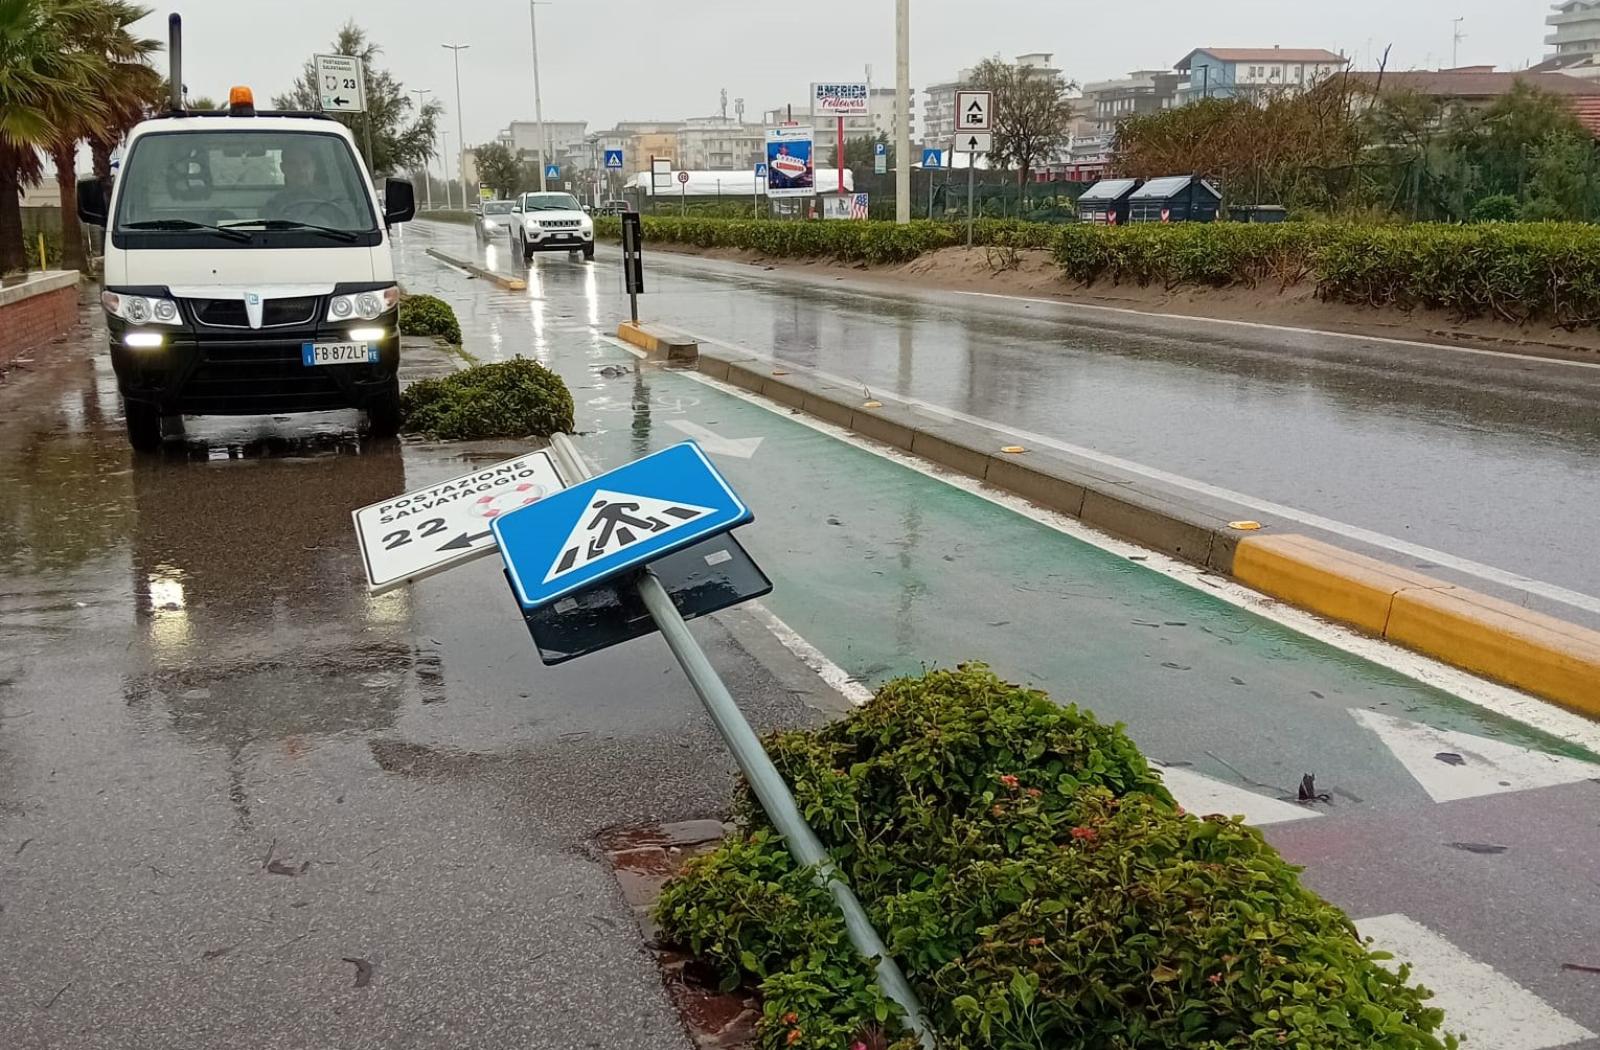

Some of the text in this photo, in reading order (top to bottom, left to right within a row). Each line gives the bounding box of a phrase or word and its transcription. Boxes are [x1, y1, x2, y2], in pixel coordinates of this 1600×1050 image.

[343, 79, 356, 89] 23
[816, 85, 867, 99] AMERICA
[820, 96, 864, 108] Followers
[876, 144, 884, 154] P
[314, 347, 329, 361] FB
[332, 345, 367, 360] 872LF
[379, 460, 527, 515] POSTAZIONE
[380, 469, 535, 525] SALVATAGGIO
[382, 517, 448, 550] 22
